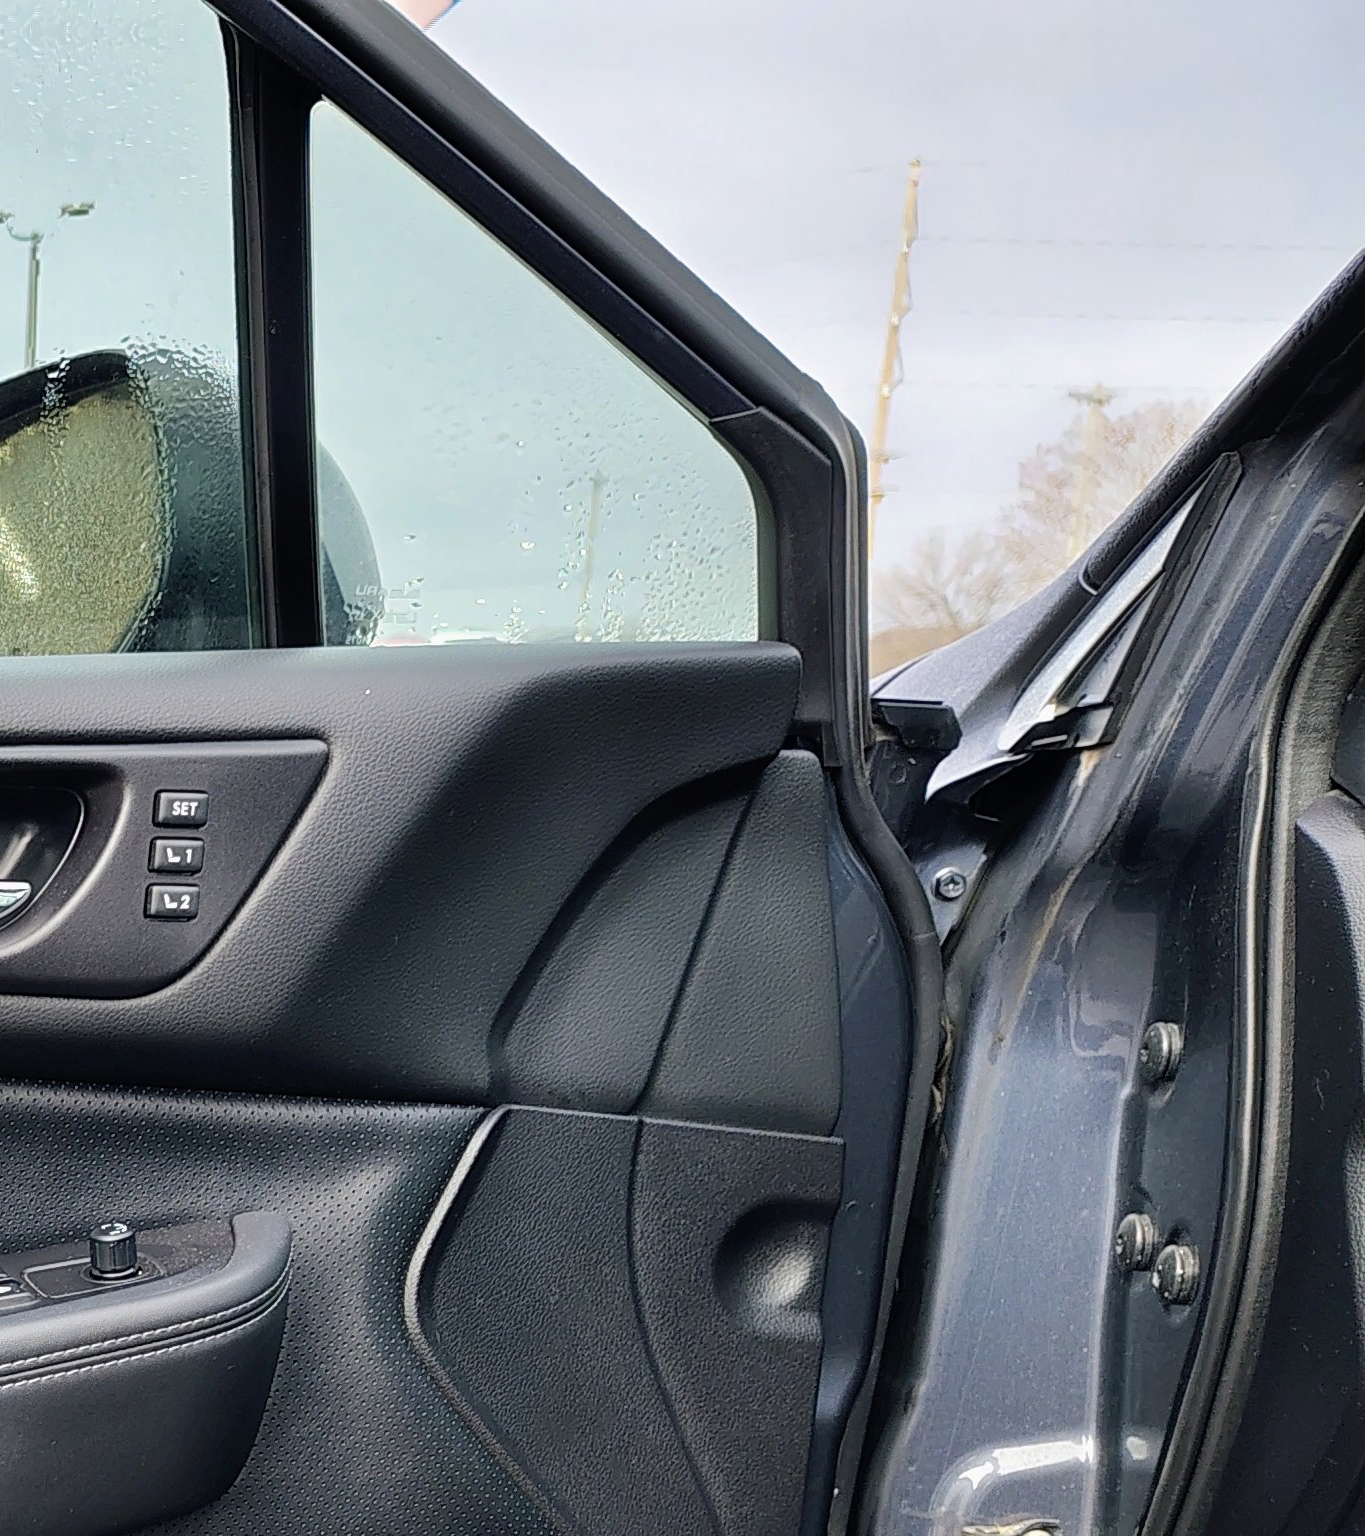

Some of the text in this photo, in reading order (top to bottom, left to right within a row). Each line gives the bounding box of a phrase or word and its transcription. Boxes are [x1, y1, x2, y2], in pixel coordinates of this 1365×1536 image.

[172, 801, 198, 816] SET
[186, 849, 193, 863] 1
[180, 895, 190, 909] 2
